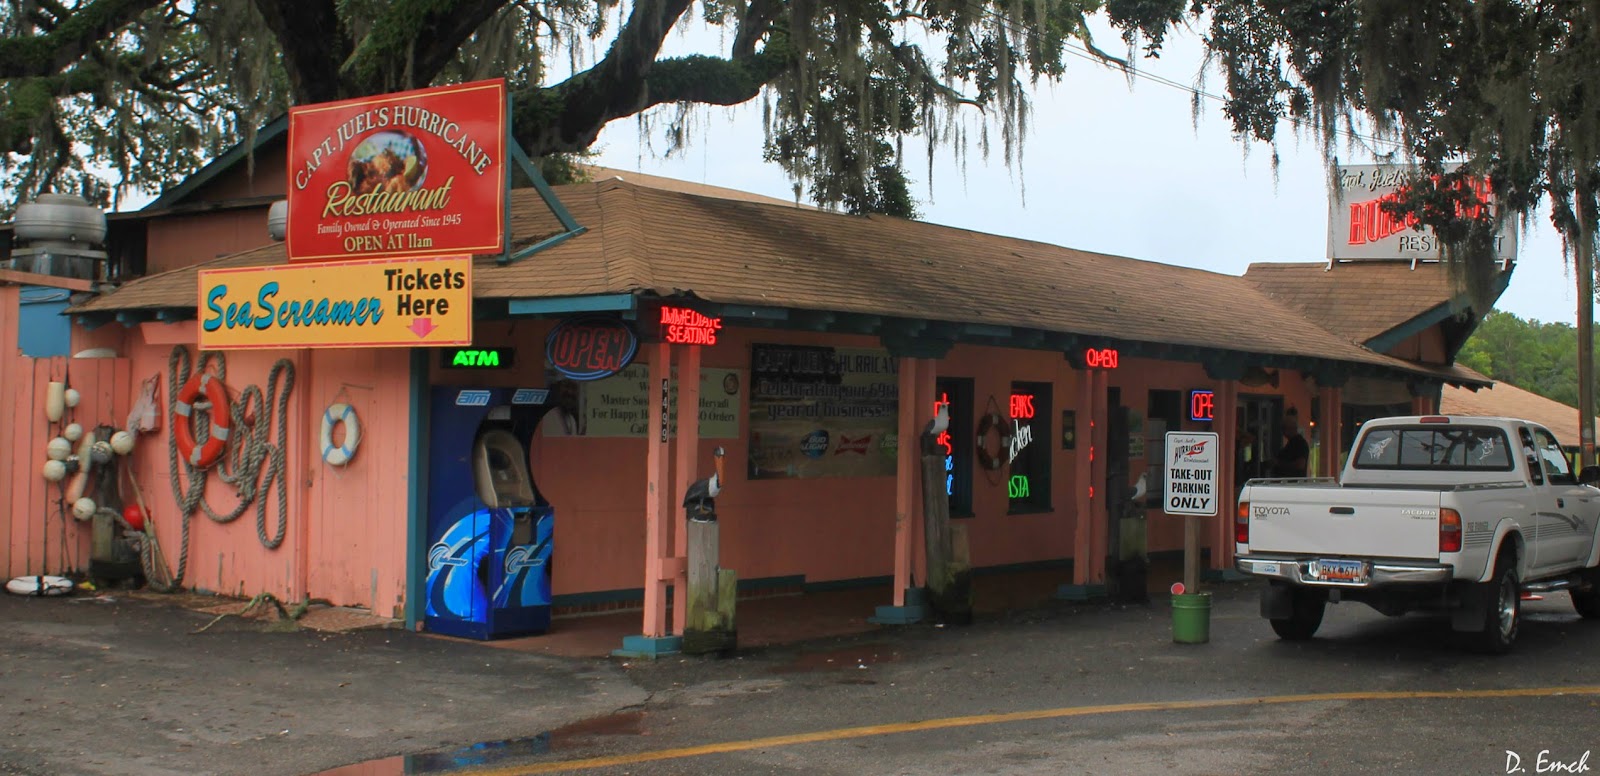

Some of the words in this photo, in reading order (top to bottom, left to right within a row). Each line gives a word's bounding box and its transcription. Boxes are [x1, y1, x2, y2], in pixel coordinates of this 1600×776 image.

[295, 137, 337, 190] CAPT.
[336, 106, 389, 151] JUEL'S
[393, 105, 492, 176] HURRICANE
[322, 176, 455, 219] Restaurant
[317, 223, 343, 237] Family
[344, 220, 370, 232] Owned
[372, 219, 381, 231] &
[383, 214, 419, 235] Operated
[421, 215, 441, 227] Since
[442, 213, 462, 226] 1945
[344, 235, 384, 252] OPEN
[387, 233, 405, 250] AT
[408, 233, 433, 249] 11am
[384, 268, 466, 291] Tickets
[396, 294, 449, 317] Here
[666, 325, 717, 345] SEATING
[553, 326, 626, 371] OPEN
[453, 350, 499, 367] ATM
[840, 353, 899, 375] HURRICAN
[1086, 348, 1118, 369] OPEN
[601, 394, 630, 406] Master
[633, 394, 650, 406] Sus
[1010, 394, 1034, 419] EAKS
[1192, 393, 1214, 418] OPE
[592, 408, 608, 419] For
[610, 408, 638, 421] Happy
[768, 403, 801, 420] year
[806, 401, 820, 418] of
[804, 442, 828, 451] LIGHT
[809, 435, 827, 444] BUD
[1171, 468, 1212, 481] TAKE-OUT
[1172, 482, 1210, 495] PARKING
[1170, 496, 1210, 510] ONLY
[1252, 505, 1291, 516] TOYOTA
